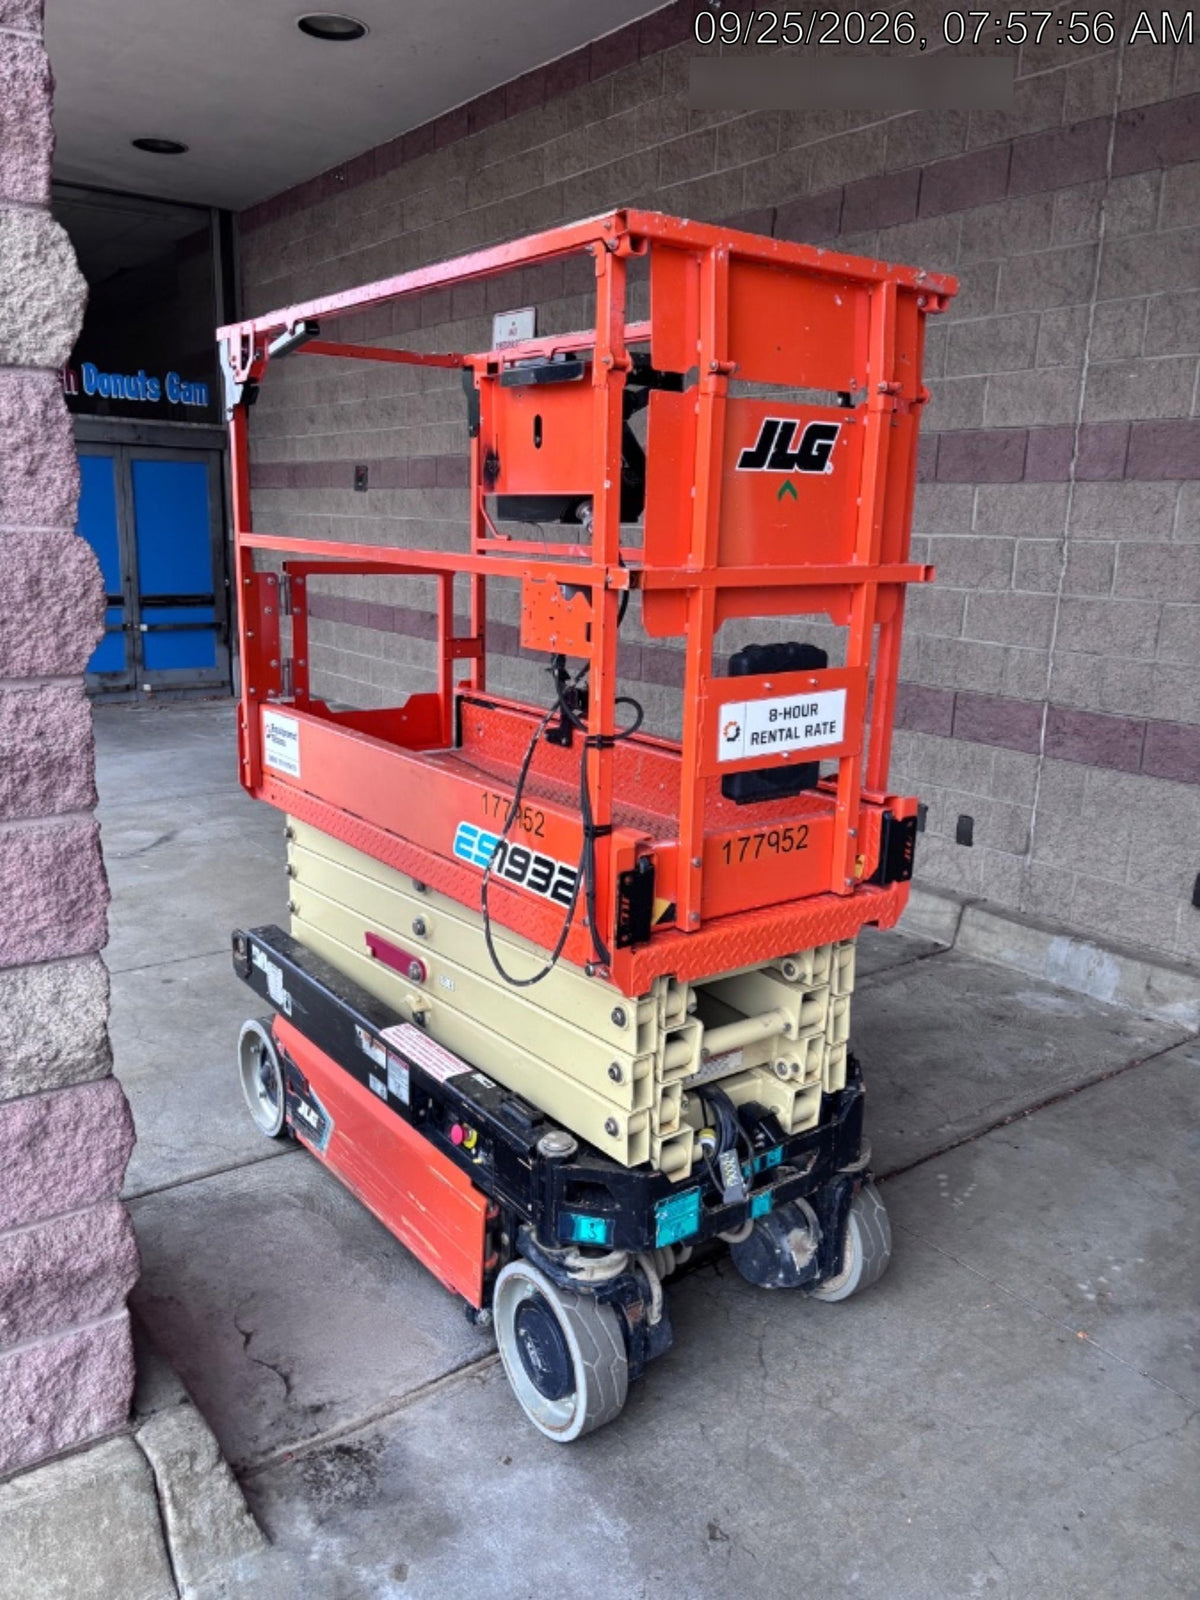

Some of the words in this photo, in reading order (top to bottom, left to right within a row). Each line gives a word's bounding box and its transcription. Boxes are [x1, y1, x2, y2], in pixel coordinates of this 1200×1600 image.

[81, 362, 161, 402] Donuts
[736, 417, 842, 474] JLG
[769, 703, 819, 722] 8-HOUR
[750, 726, 801, 746] RENTAL
[804, 720, 837, 738] RATE
[722, 825, 809, 865] 177952
